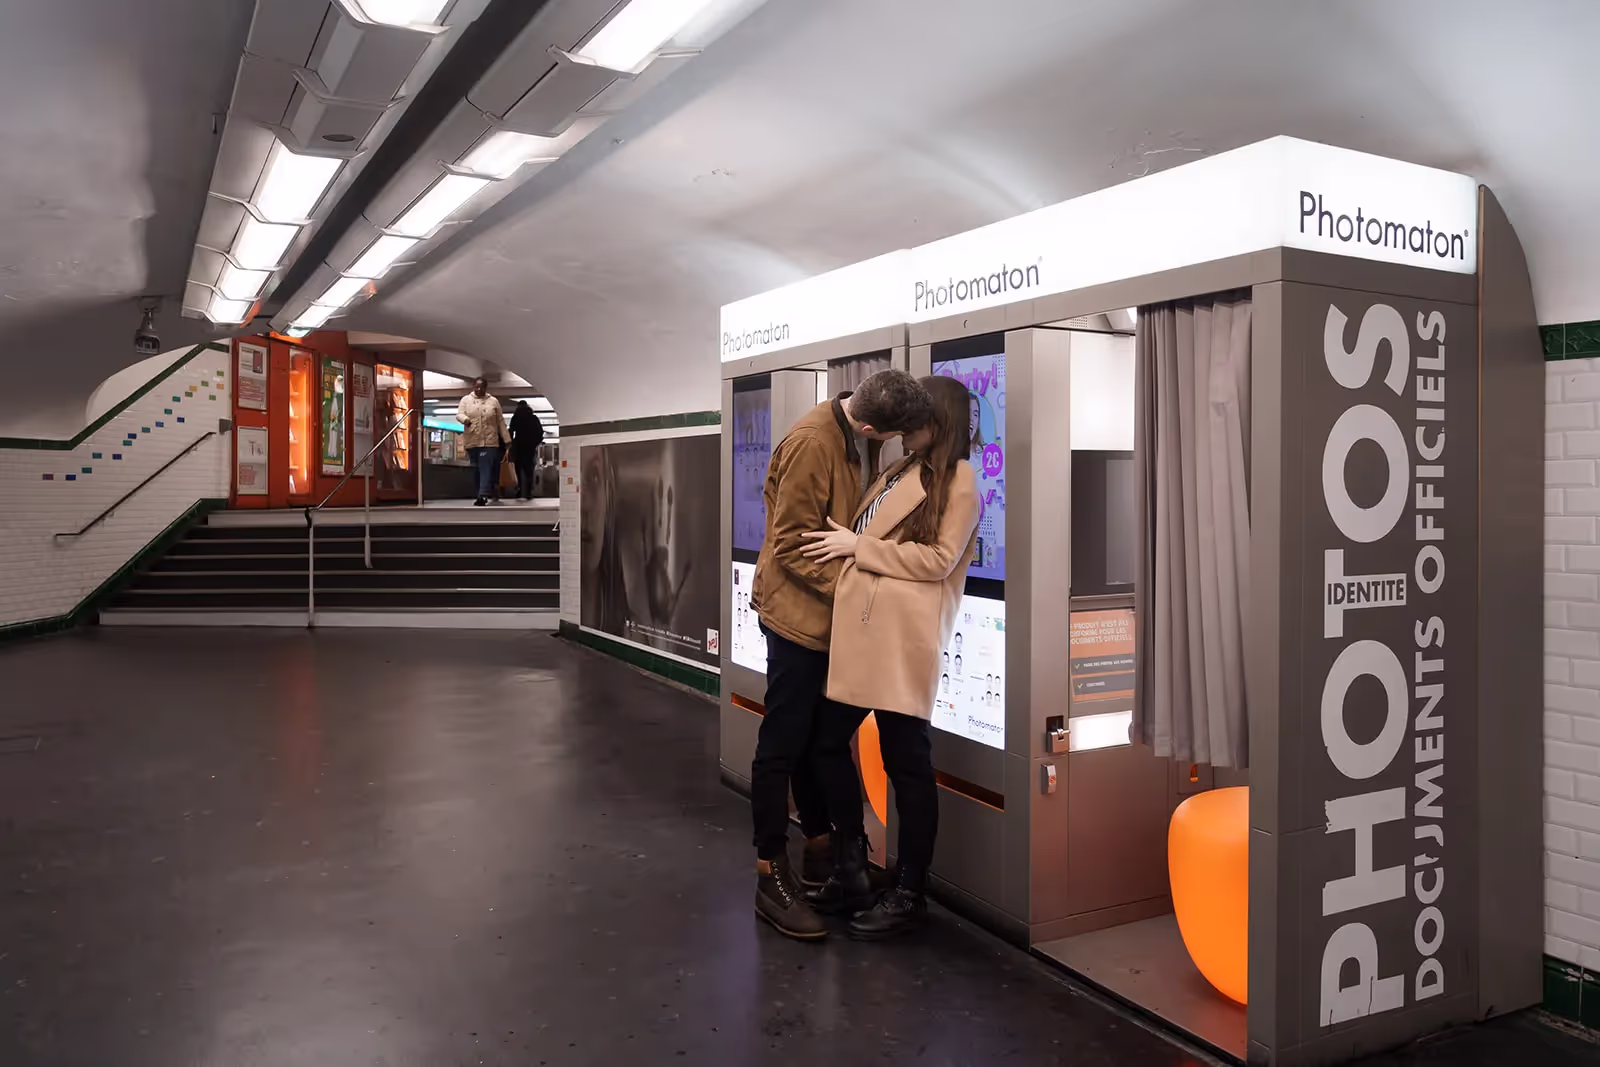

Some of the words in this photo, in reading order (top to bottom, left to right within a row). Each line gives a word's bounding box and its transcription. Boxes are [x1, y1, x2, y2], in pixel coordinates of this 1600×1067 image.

[722, 321, 790, 356] Photomaton
[1414, 310, 1446, 594] OFFICIELS
[1320, 303, 1410, 1028] PHOTOS
[1327, 578, 1405, 606] IDENTITE
[1414, 615, 1445, 1001] DOCUMENTS
